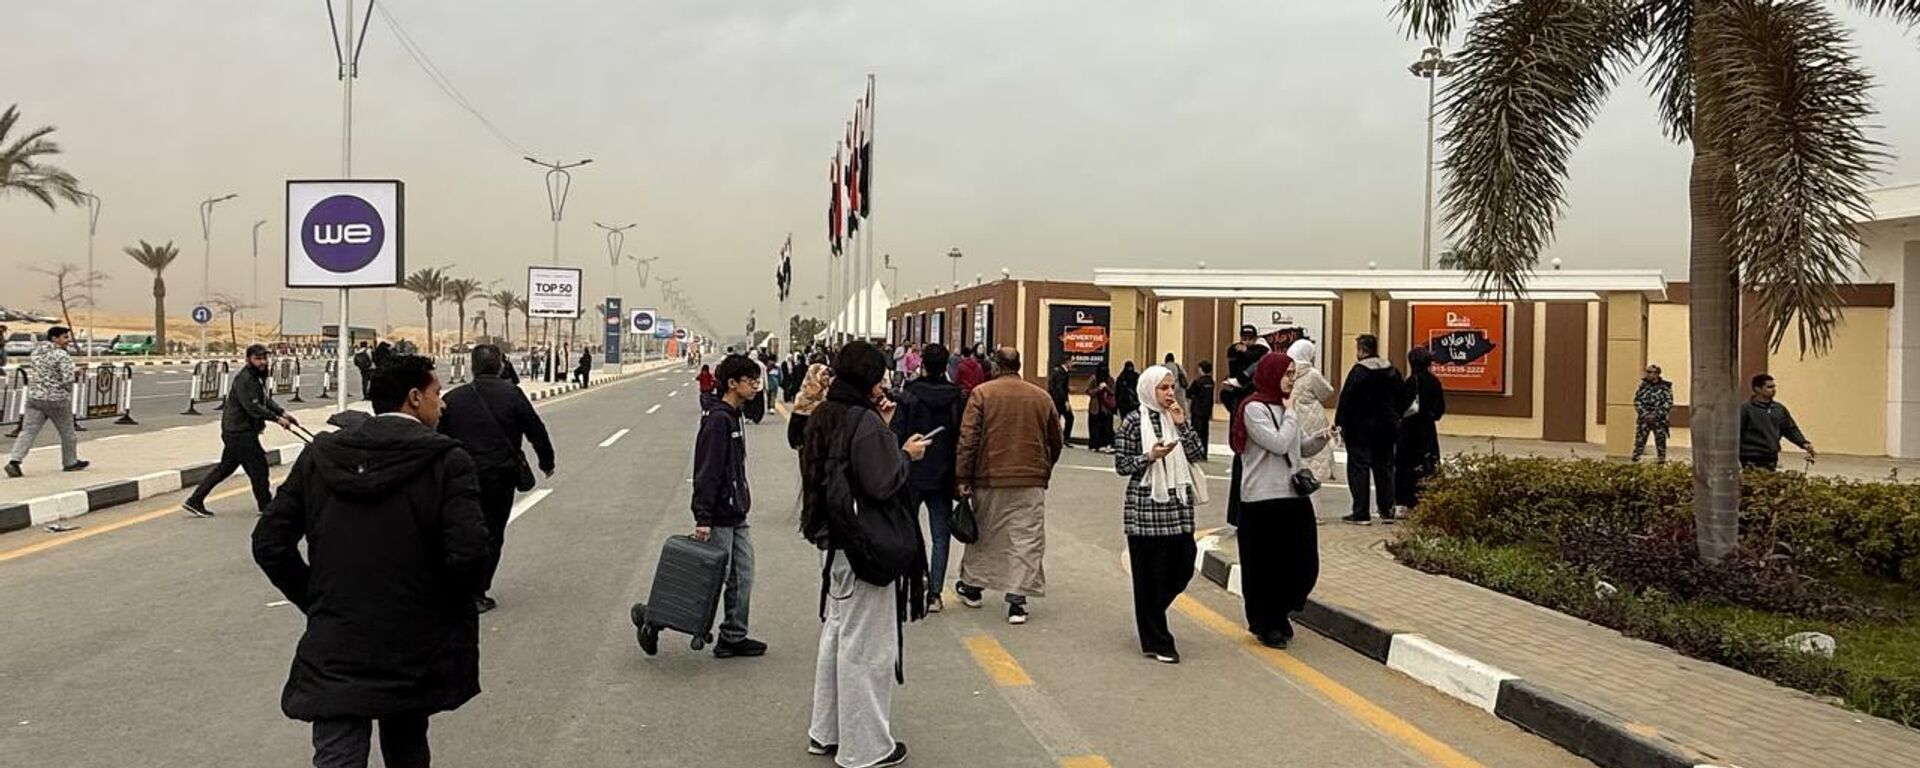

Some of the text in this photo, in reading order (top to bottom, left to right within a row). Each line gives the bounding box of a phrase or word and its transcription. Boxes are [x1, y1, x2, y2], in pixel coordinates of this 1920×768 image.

[535, 283, 573, 293] TOP 50
[1065, 334, 1104, 342] ADVERTISE
[1449, 347, 1467, 360] هنا
